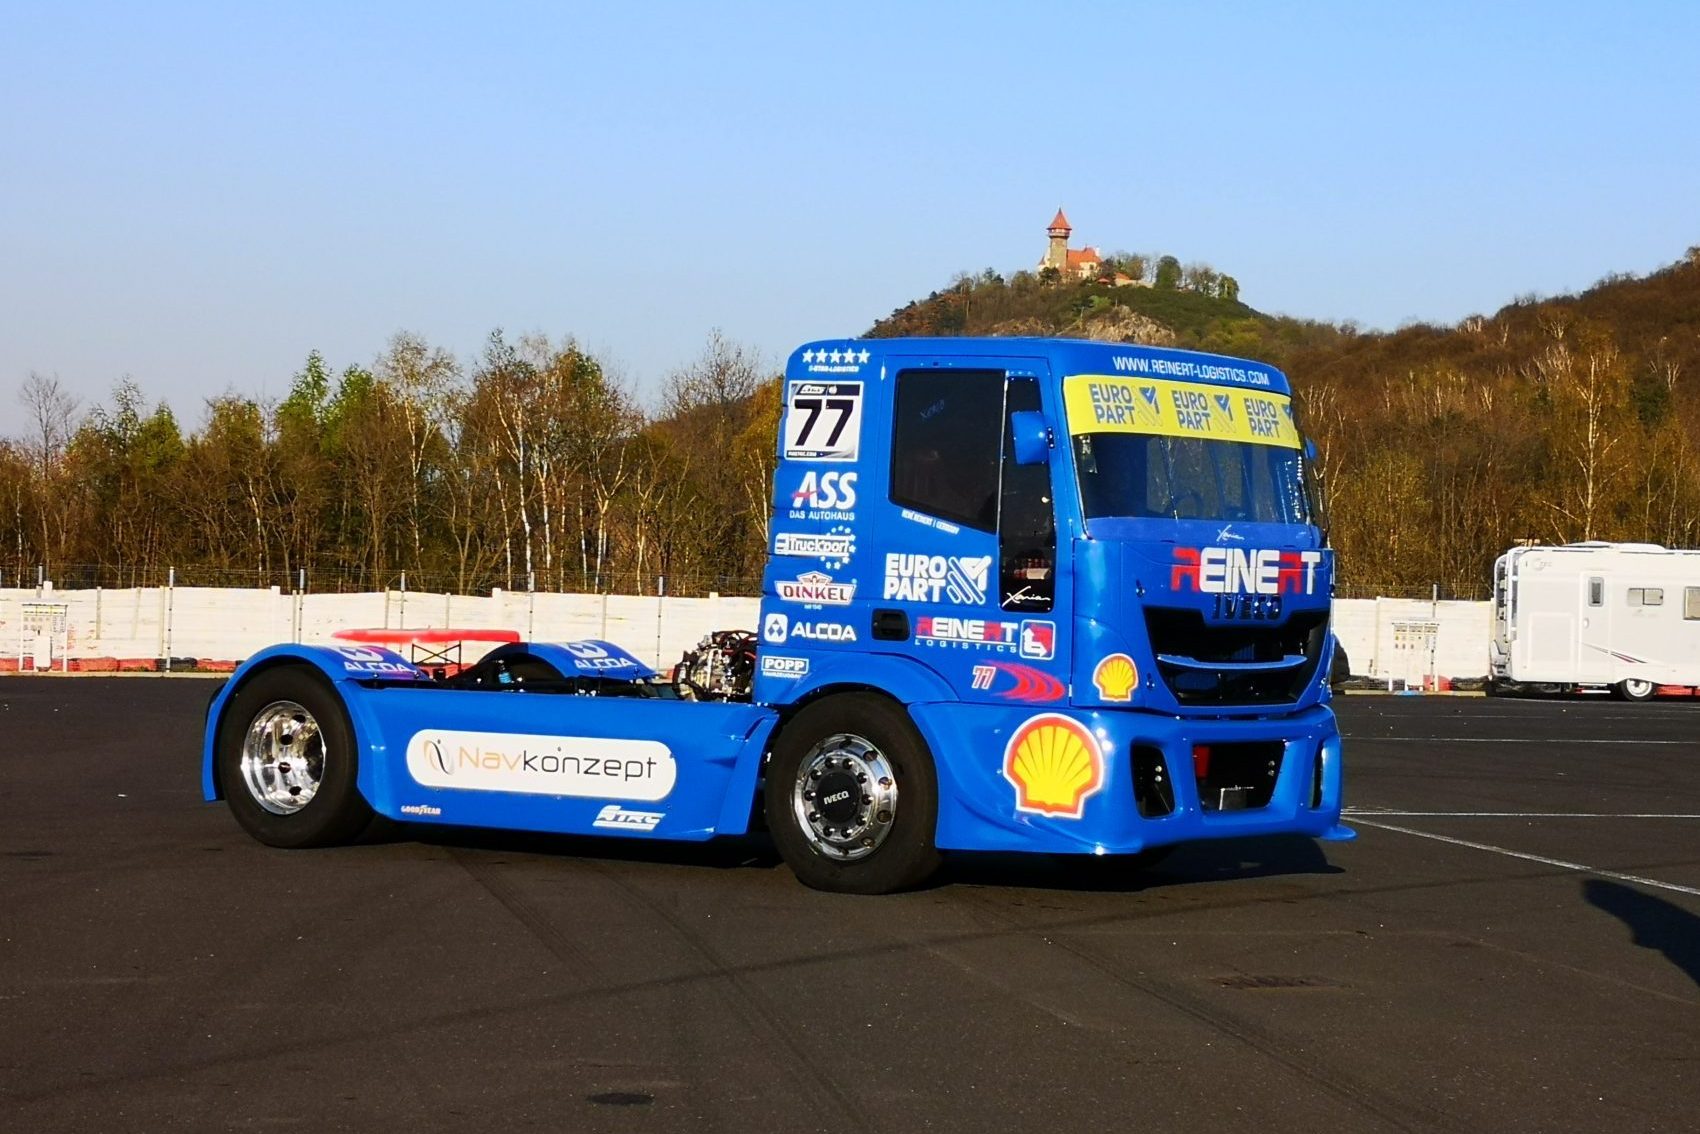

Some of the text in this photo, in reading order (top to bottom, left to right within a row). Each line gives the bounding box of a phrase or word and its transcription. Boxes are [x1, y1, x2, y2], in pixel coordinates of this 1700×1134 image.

[1112, 356, 1270, 386] WWW.REINERT-LOGISTICS.COM
[1088, 383, 1133, 404] EURO
[1171, 389, 1209, 411] EURO
[1094, 404, 1136, 425] PART
[1243, 397, 1278, 419] EURO
[794, 399, 854, 447] 77
[1176, 411, 1212, 432] PART
[1249, 417, 1280, 438] PART
[792, 471, 858, 510] ASS
[789, 510, 855, 521] DAS AUTOHAUS
[885, 553, 948, 579] EURO
[1171, 547, 1321, 595] REINERT
[783, 585, 848, 601] DINKEL
[883, 576, 947, 603] PART
[791, 621, 857, 642] ALCOA
[916, 616, 1019, 643] REINERT
[914, 639, 1018, 653] LOGISTICS
[343, 661, 417, 674] ALCOA
[574, 657, 638, 669] ALCOA
[764, 658, 805, 671] POPP
[971, 665, 997, 690] 77
[458, 746, 658, 782] Navkonzept
[823, 790, 850, 805] IVECO
